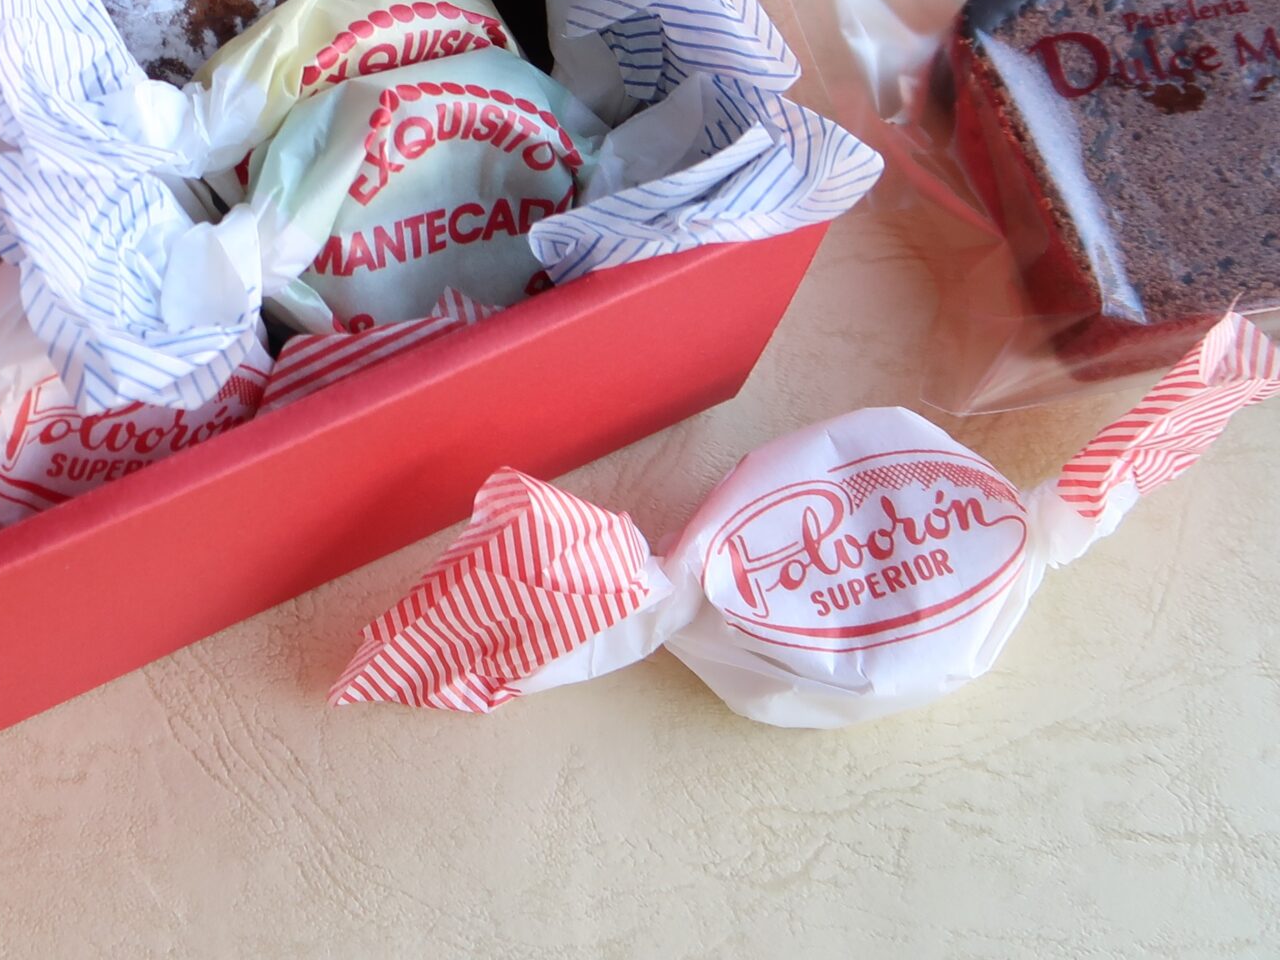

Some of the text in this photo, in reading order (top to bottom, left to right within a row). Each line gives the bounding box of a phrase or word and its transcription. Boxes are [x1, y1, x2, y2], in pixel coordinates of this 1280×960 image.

[1028, 31, 1222, 99] Dulce
[349, 101, 556, 206] EXQUISITO
[305, 187, 575, 278] MANTECAD
[810, 549, 954, 617] SUPERIOR
